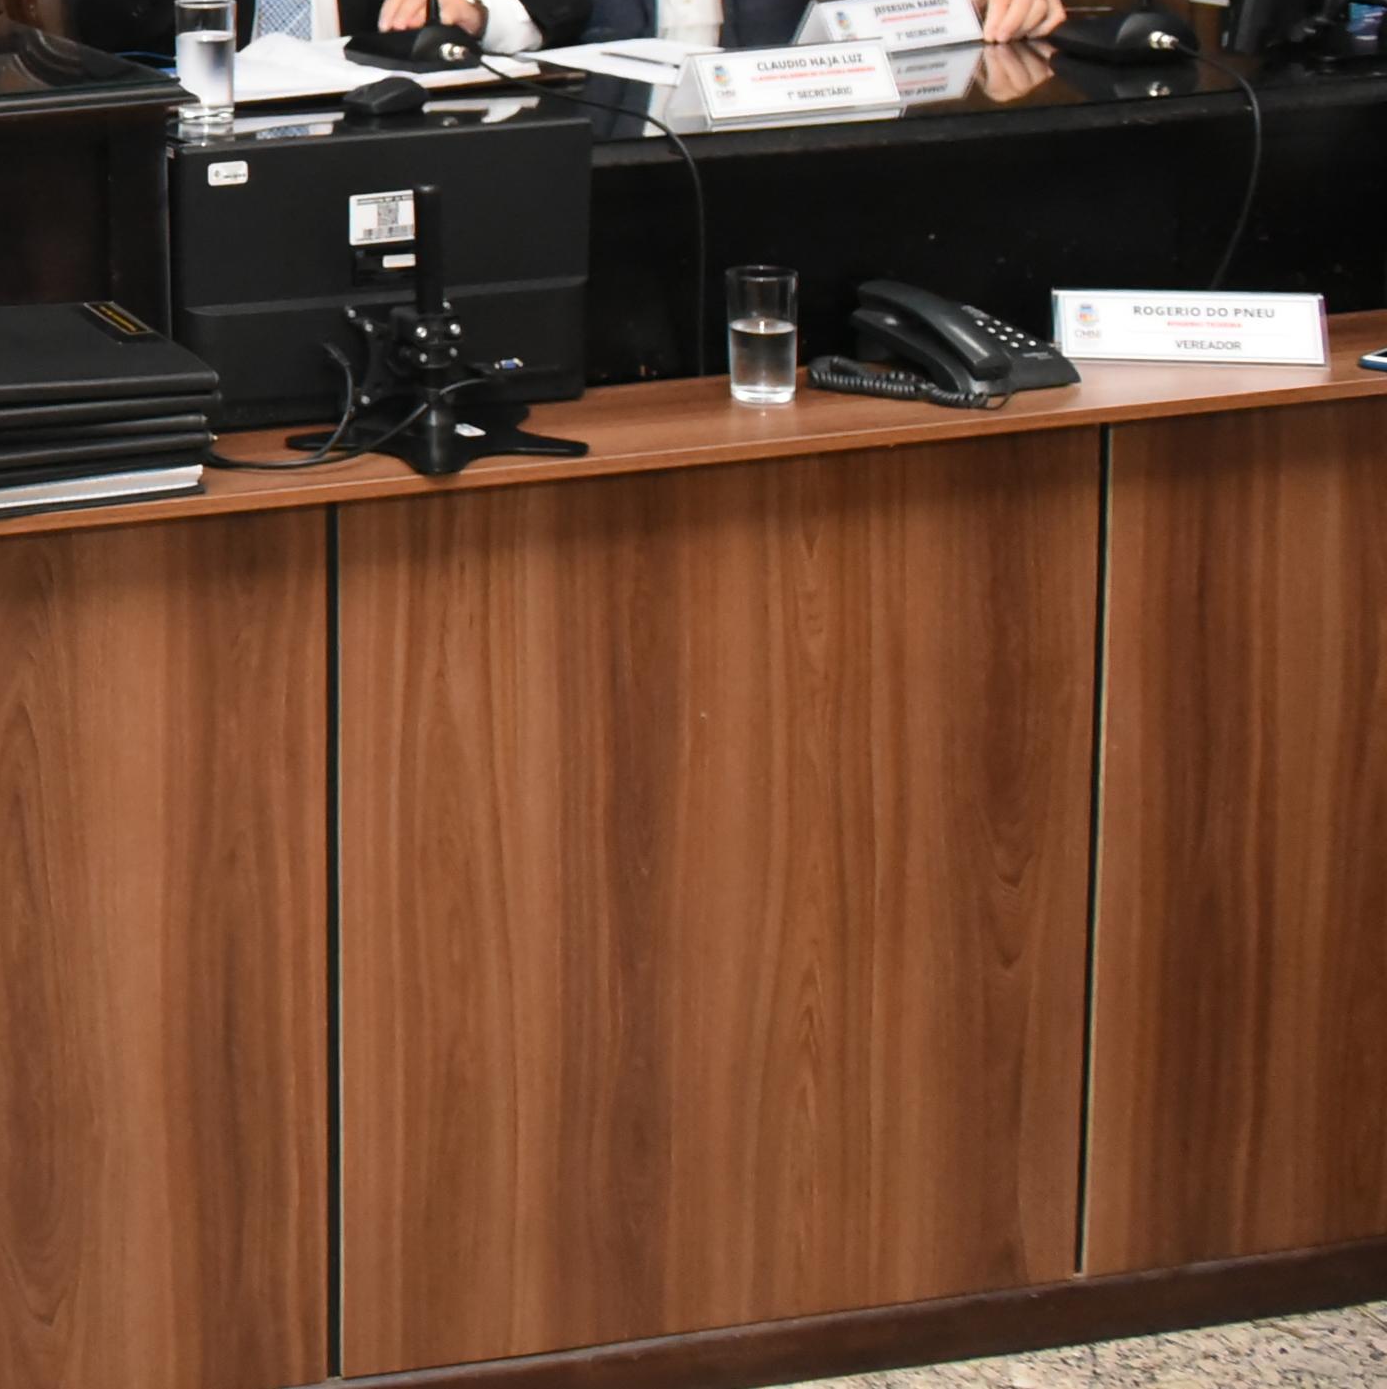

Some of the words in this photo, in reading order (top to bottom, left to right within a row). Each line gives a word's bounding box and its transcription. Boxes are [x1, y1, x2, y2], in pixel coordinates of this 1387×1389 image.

[756, 58, 808, 73] CLAUDIO
[810, 56, 840, 69] HAJA
[842, 53, 863, 66] LUZ
[796, 85, 853, 100] SECRETÁRIO
[1133, 306, 1201, 317] ROGERIO
[1206, 307, 1229, 317] DO
[1234, 308, 1275, 318] PNEU
[1175, 340, 1242, 350] VEREADOR
